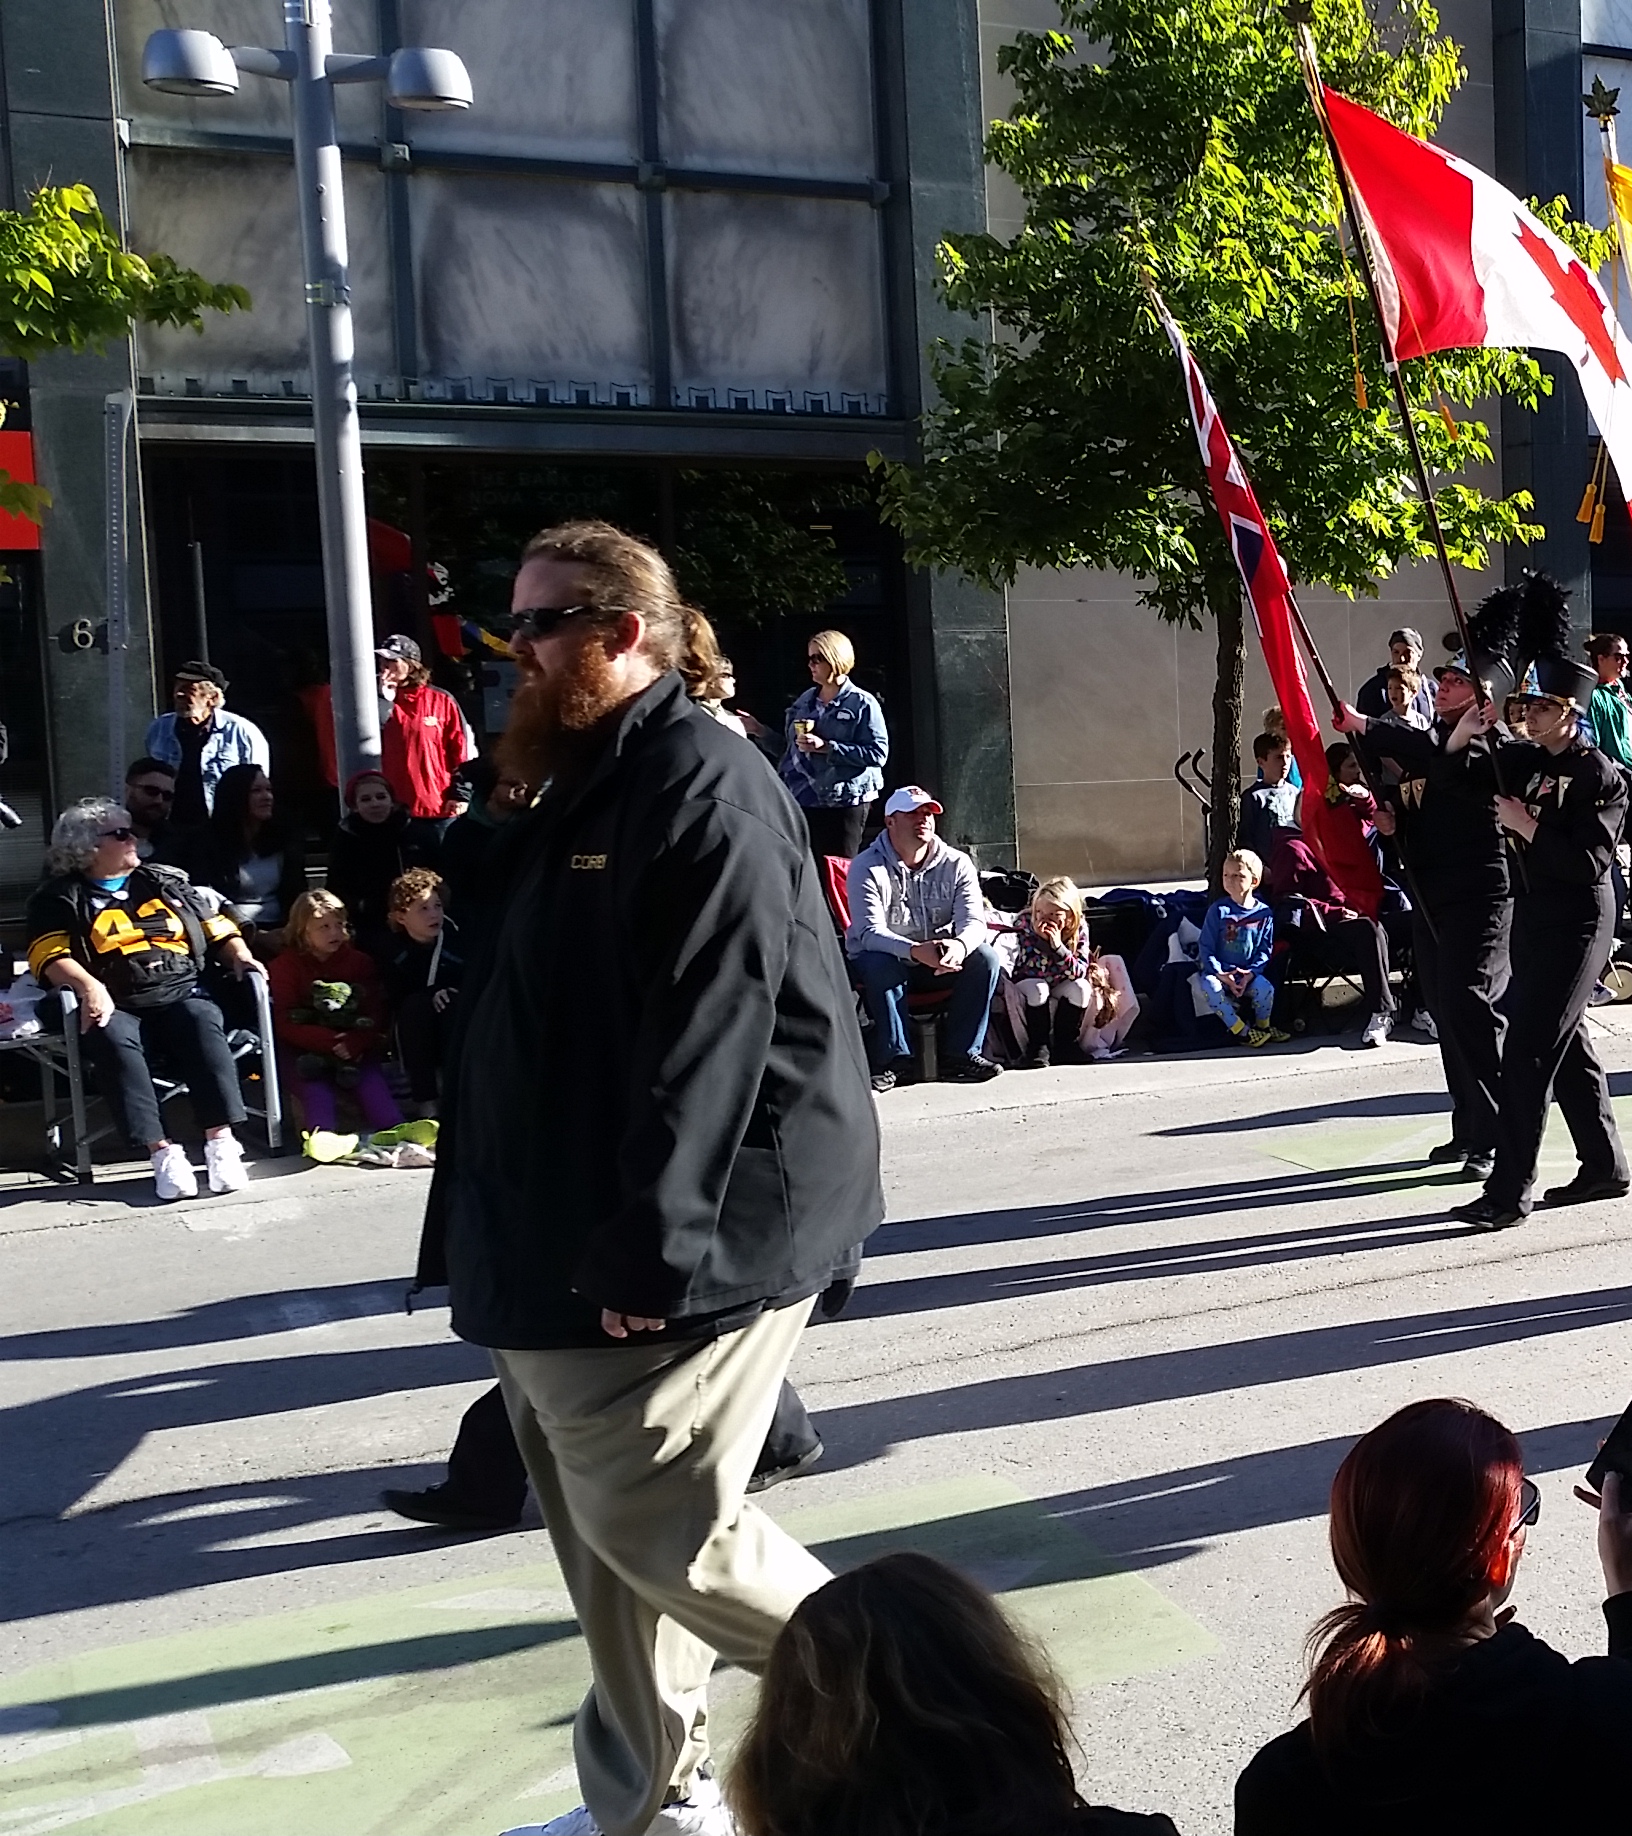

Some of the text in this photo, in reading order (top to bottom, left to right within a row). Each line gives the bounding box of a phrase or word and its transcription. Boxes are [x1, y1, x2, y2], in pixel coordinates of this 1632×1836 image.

[469, 471, 610, 488] THE BANK OF
[470, 490, 524, 506] NOVA
